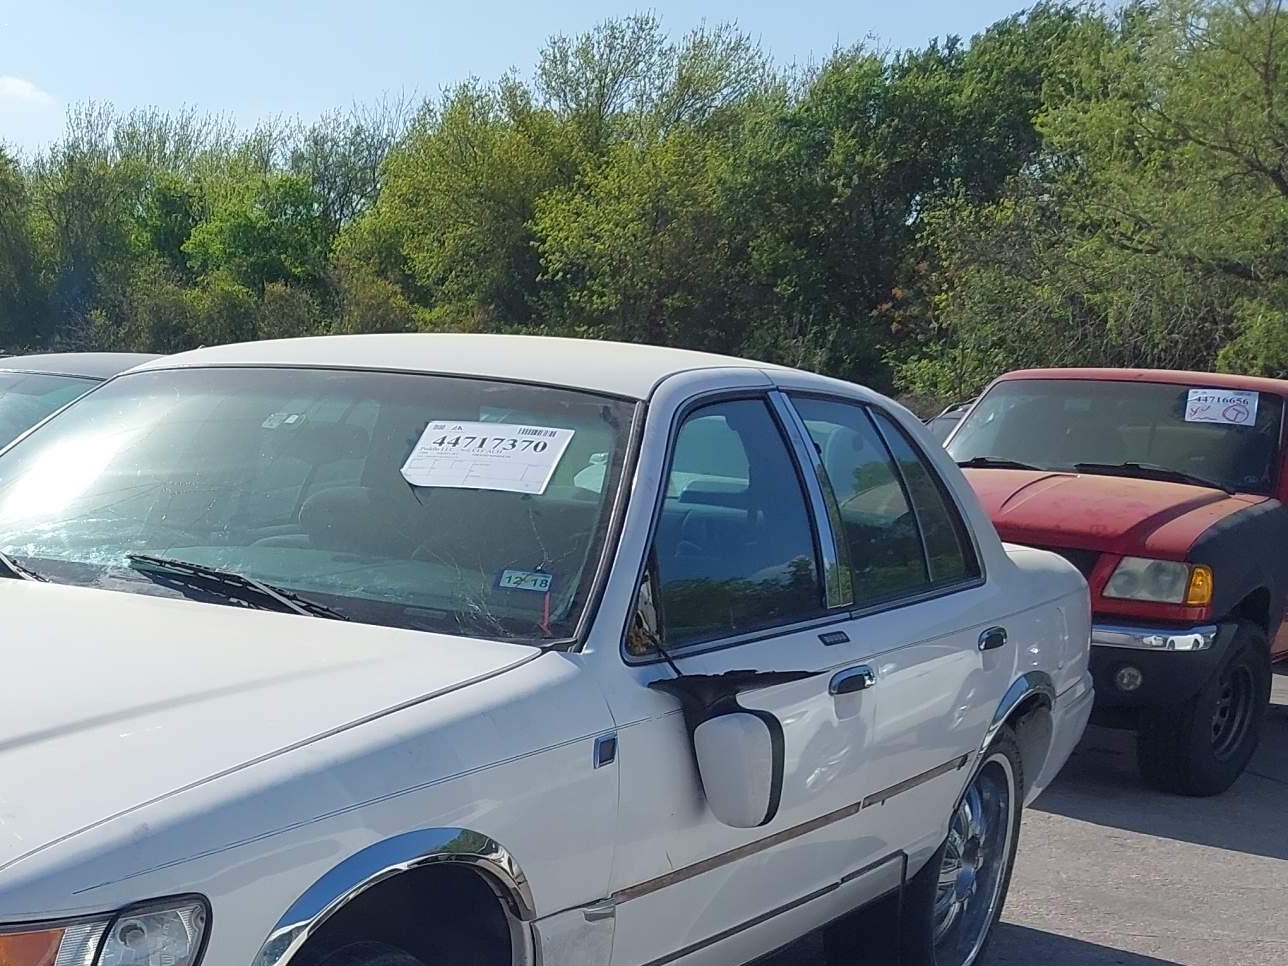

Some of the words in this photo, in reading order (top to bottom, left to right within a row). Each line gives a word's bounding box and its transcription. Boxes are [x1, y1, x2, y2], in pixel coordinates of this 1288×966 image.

[1194, 395, 1249, 405] 44716656
[432, 435, 549, 453] 44717370
[531, 578, 549, 588] 18
